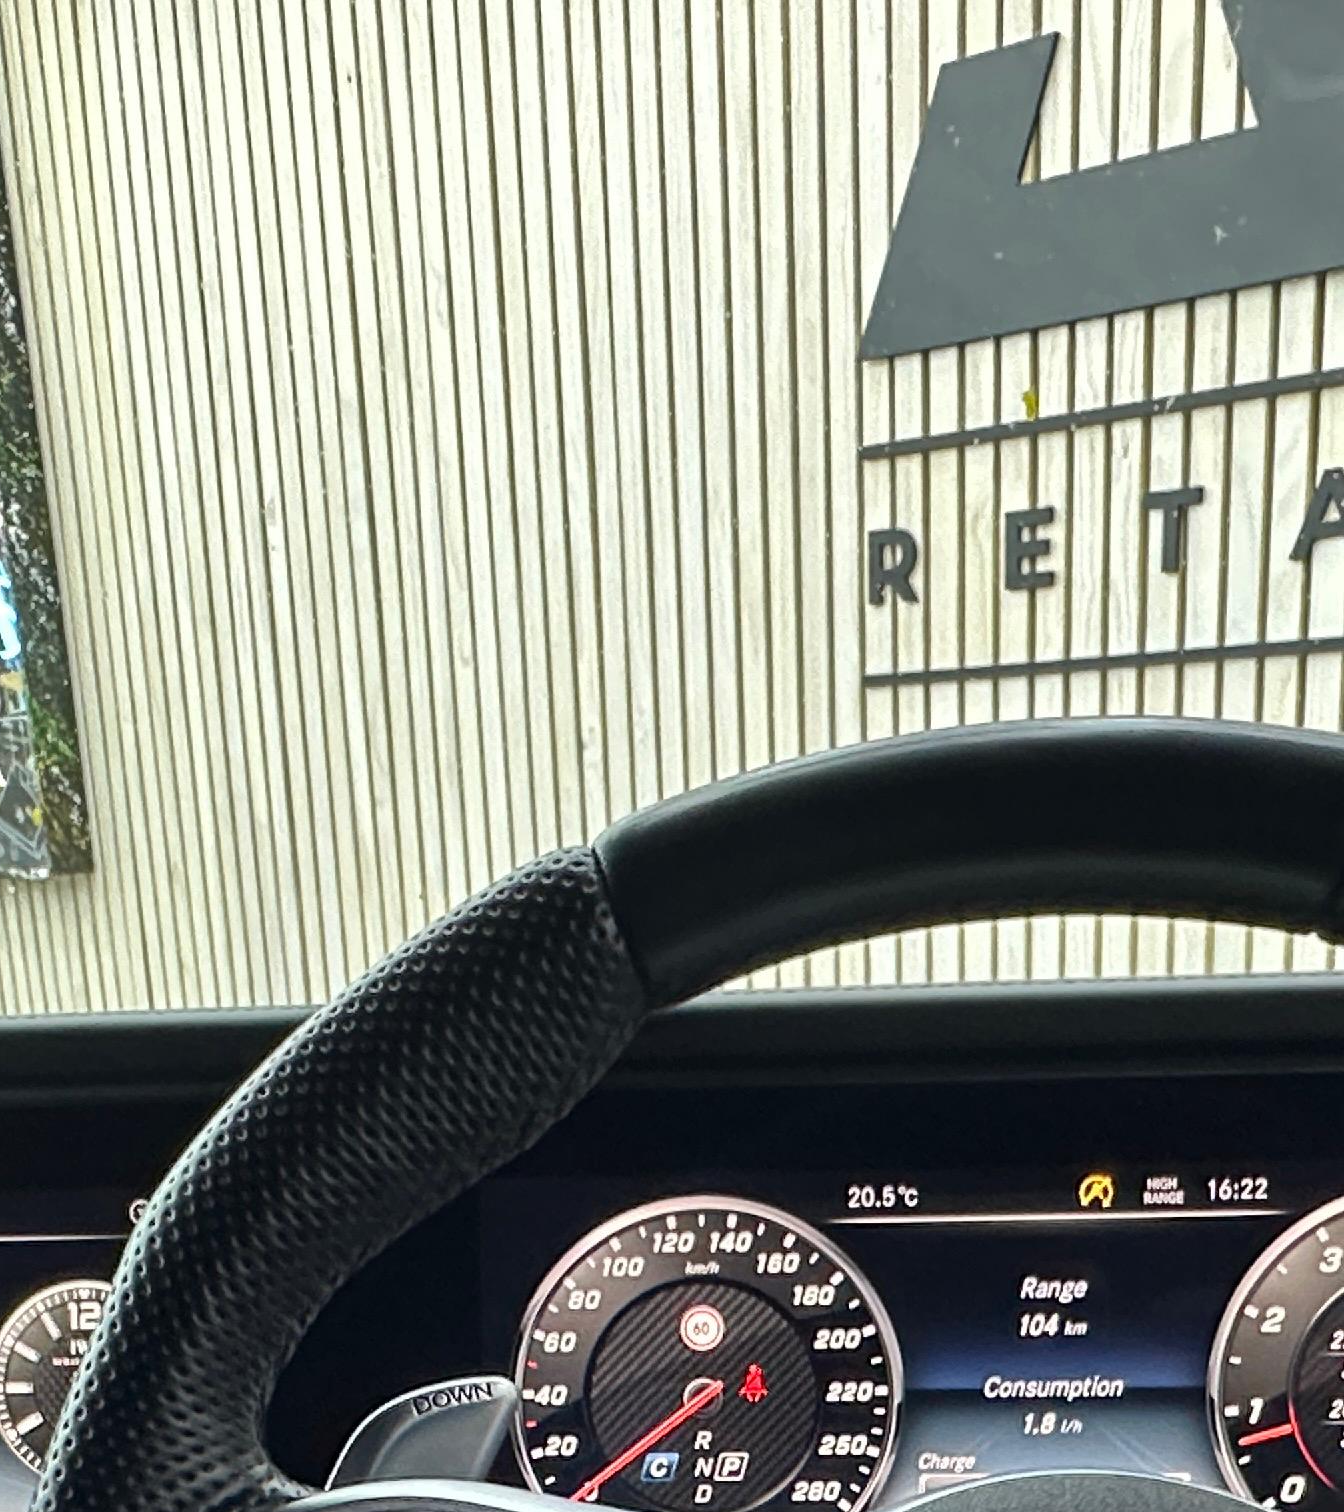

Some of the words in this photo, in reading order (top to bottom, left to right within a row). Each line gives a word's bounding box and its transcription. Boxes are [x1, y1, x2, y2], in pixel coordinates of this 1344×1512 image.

[1146, 1177, 1178, 1190] HIGH
[1207, 1177, 1268, 1201] 16:22
[1143, 1189, 1185, 1205] RANGE
[653, 1231, 695, 1253] 120
[709, 1231, 753, 1253] 140
[602, 1256, 644, 1277] 100
[684, 1261, 720, 1275] km/h
[756, 1252, 800, 1274] 160
[1319, 1246, 1344, 1273] 3
[567, 1289, 601, 1310] 80
[792, 1284, 836, 1306] 180
[1020, 1275, 1089, 1303] Range
[66, 1300, 102, 1330] 12
[1019, 1313, 1060, 1337] 104
[1063, 1320, 1089, 1336] km
[1260, 1305, 1287, 1333] 2
[544, 1331, 577, 1353] 60
[813, 1327, 862, 1350] 200
[412, 1382, 494, 1416] DOWN
[534, 1384, 568, 1406] 40
[825, 1380, 875, 1402] 220
[983, 1375, 1124, 1402] Consumption
[1248, 1397, 1264, 1424] 1
[544, 1434, 579, 1457] 20
[694, 1430, 713, 1450] R
[818, 1434, 869, 1456] 250
[649, 1456, 669, 1478] C
[694, 1457, 714, 1478] N
[721, 1456, 742, 1477] P
[917, 1452, 976, 1472] Charge
[694, 1483, 713, 1504] D
[791, 1480, 842, 1502] 280
[1279, 1474, 1306, 1503] 0
